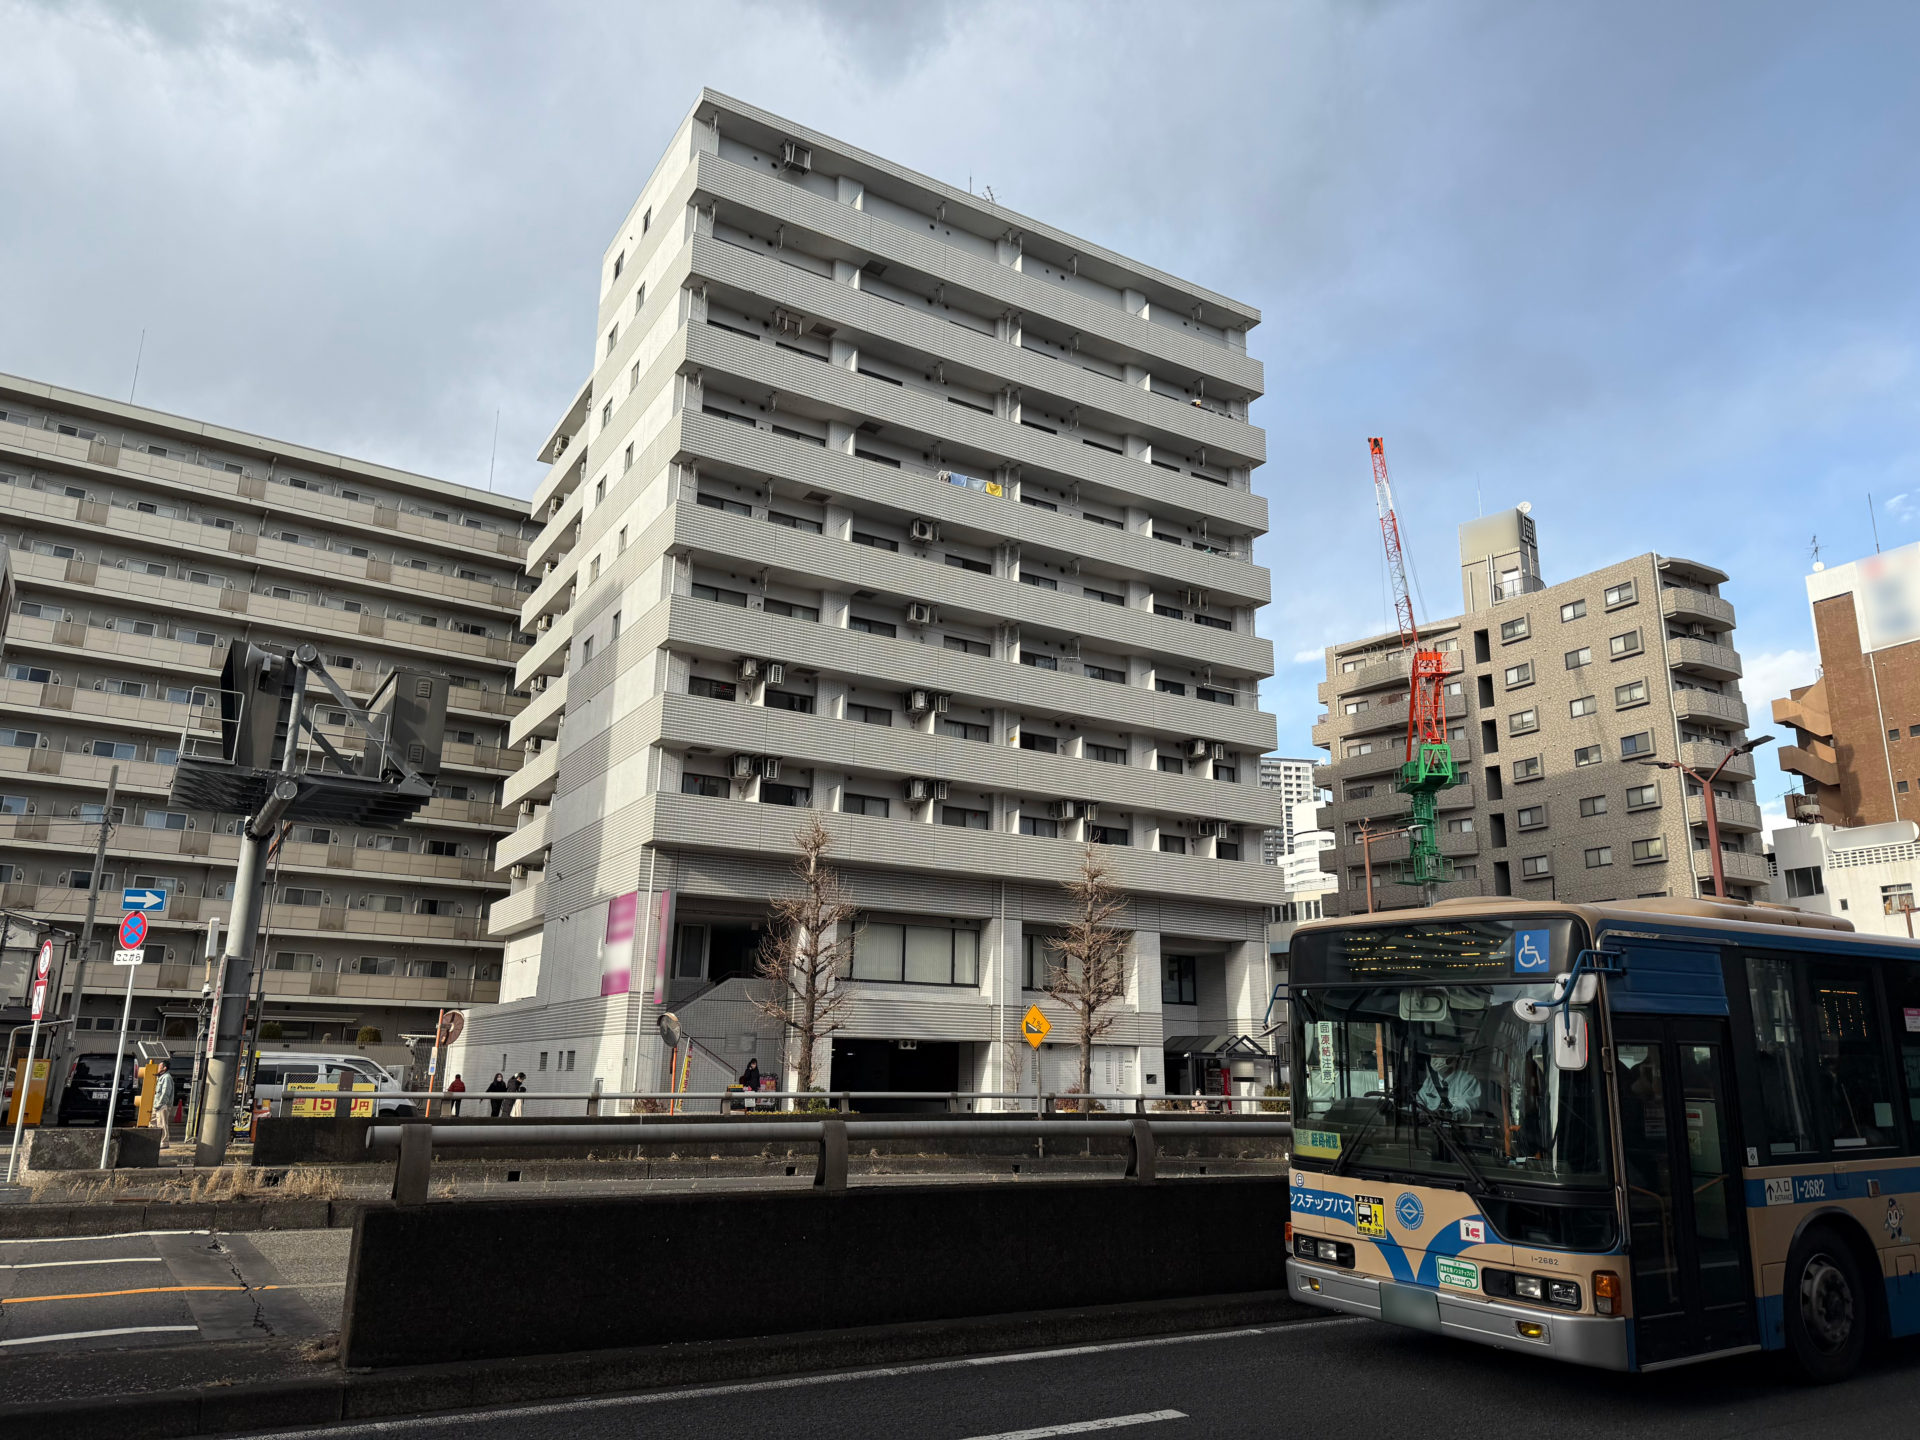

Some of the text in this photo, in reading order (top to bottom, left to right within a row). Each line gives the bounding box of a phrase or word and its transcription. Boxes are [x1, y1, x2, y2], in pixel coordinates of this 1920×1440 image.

[116, 953, 141, 962] ここから
[1032, 1017, 1043, 1029] 7%
[312, 1097, 369, 1111] 15円
[1776, 1180, 1790, 1193] 入口
[1290, 1192, 1354, 1215] ンステップバス
